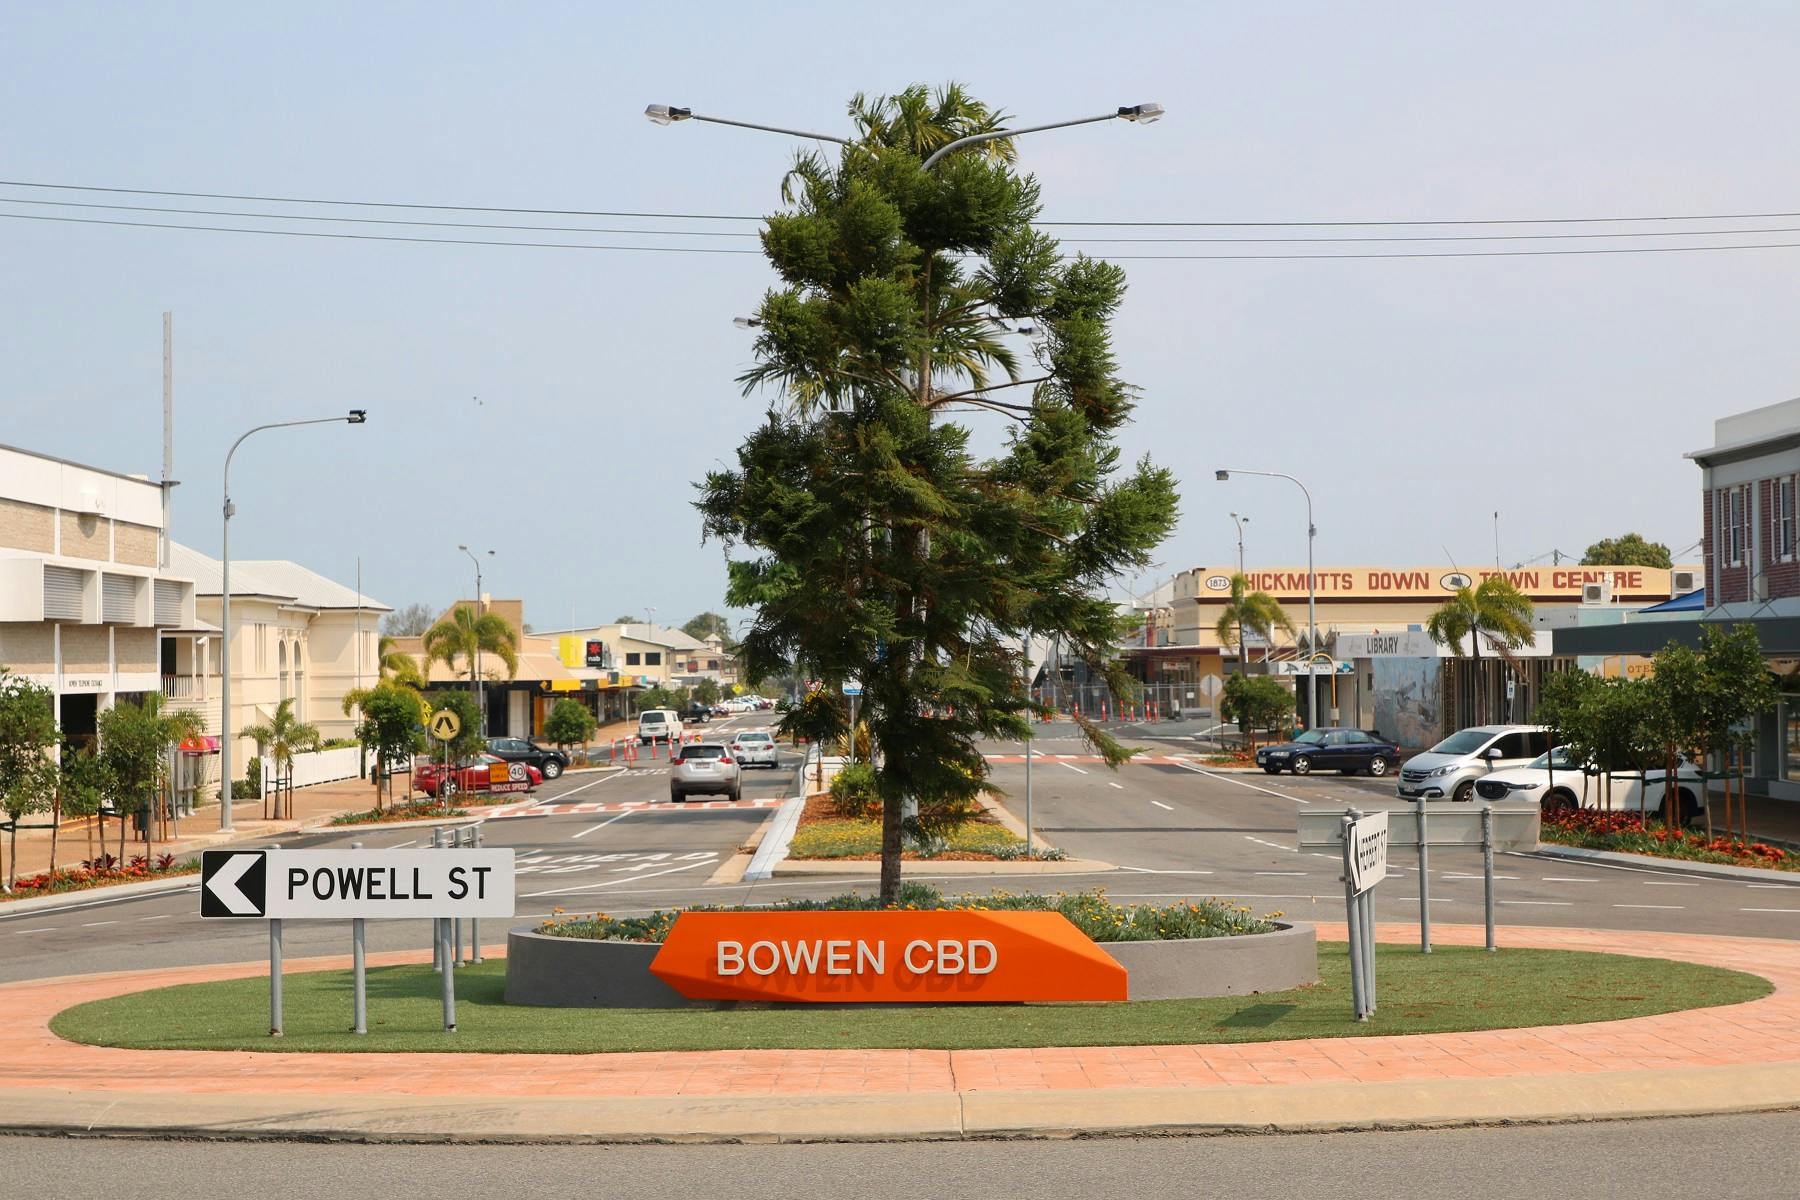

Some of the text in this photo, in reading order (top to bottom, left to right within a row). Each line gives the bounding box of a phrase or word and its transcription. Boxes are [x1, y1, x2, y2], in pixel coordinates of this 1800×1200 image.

[1210, 579, 1227, 587] 1873
[1244, 573, 1352, 590] HICKMOTTS
[1369, 573, 1429, 590] DOWN
[1366, 636, 1399, 654] LIBRARY
[511, 767, 523, 776] 40
[512, 783, 528, 791] SPEED
[288, 866, 492, 900] POWELL ST
[716, 939, 998, 976] BOWEN CBD
